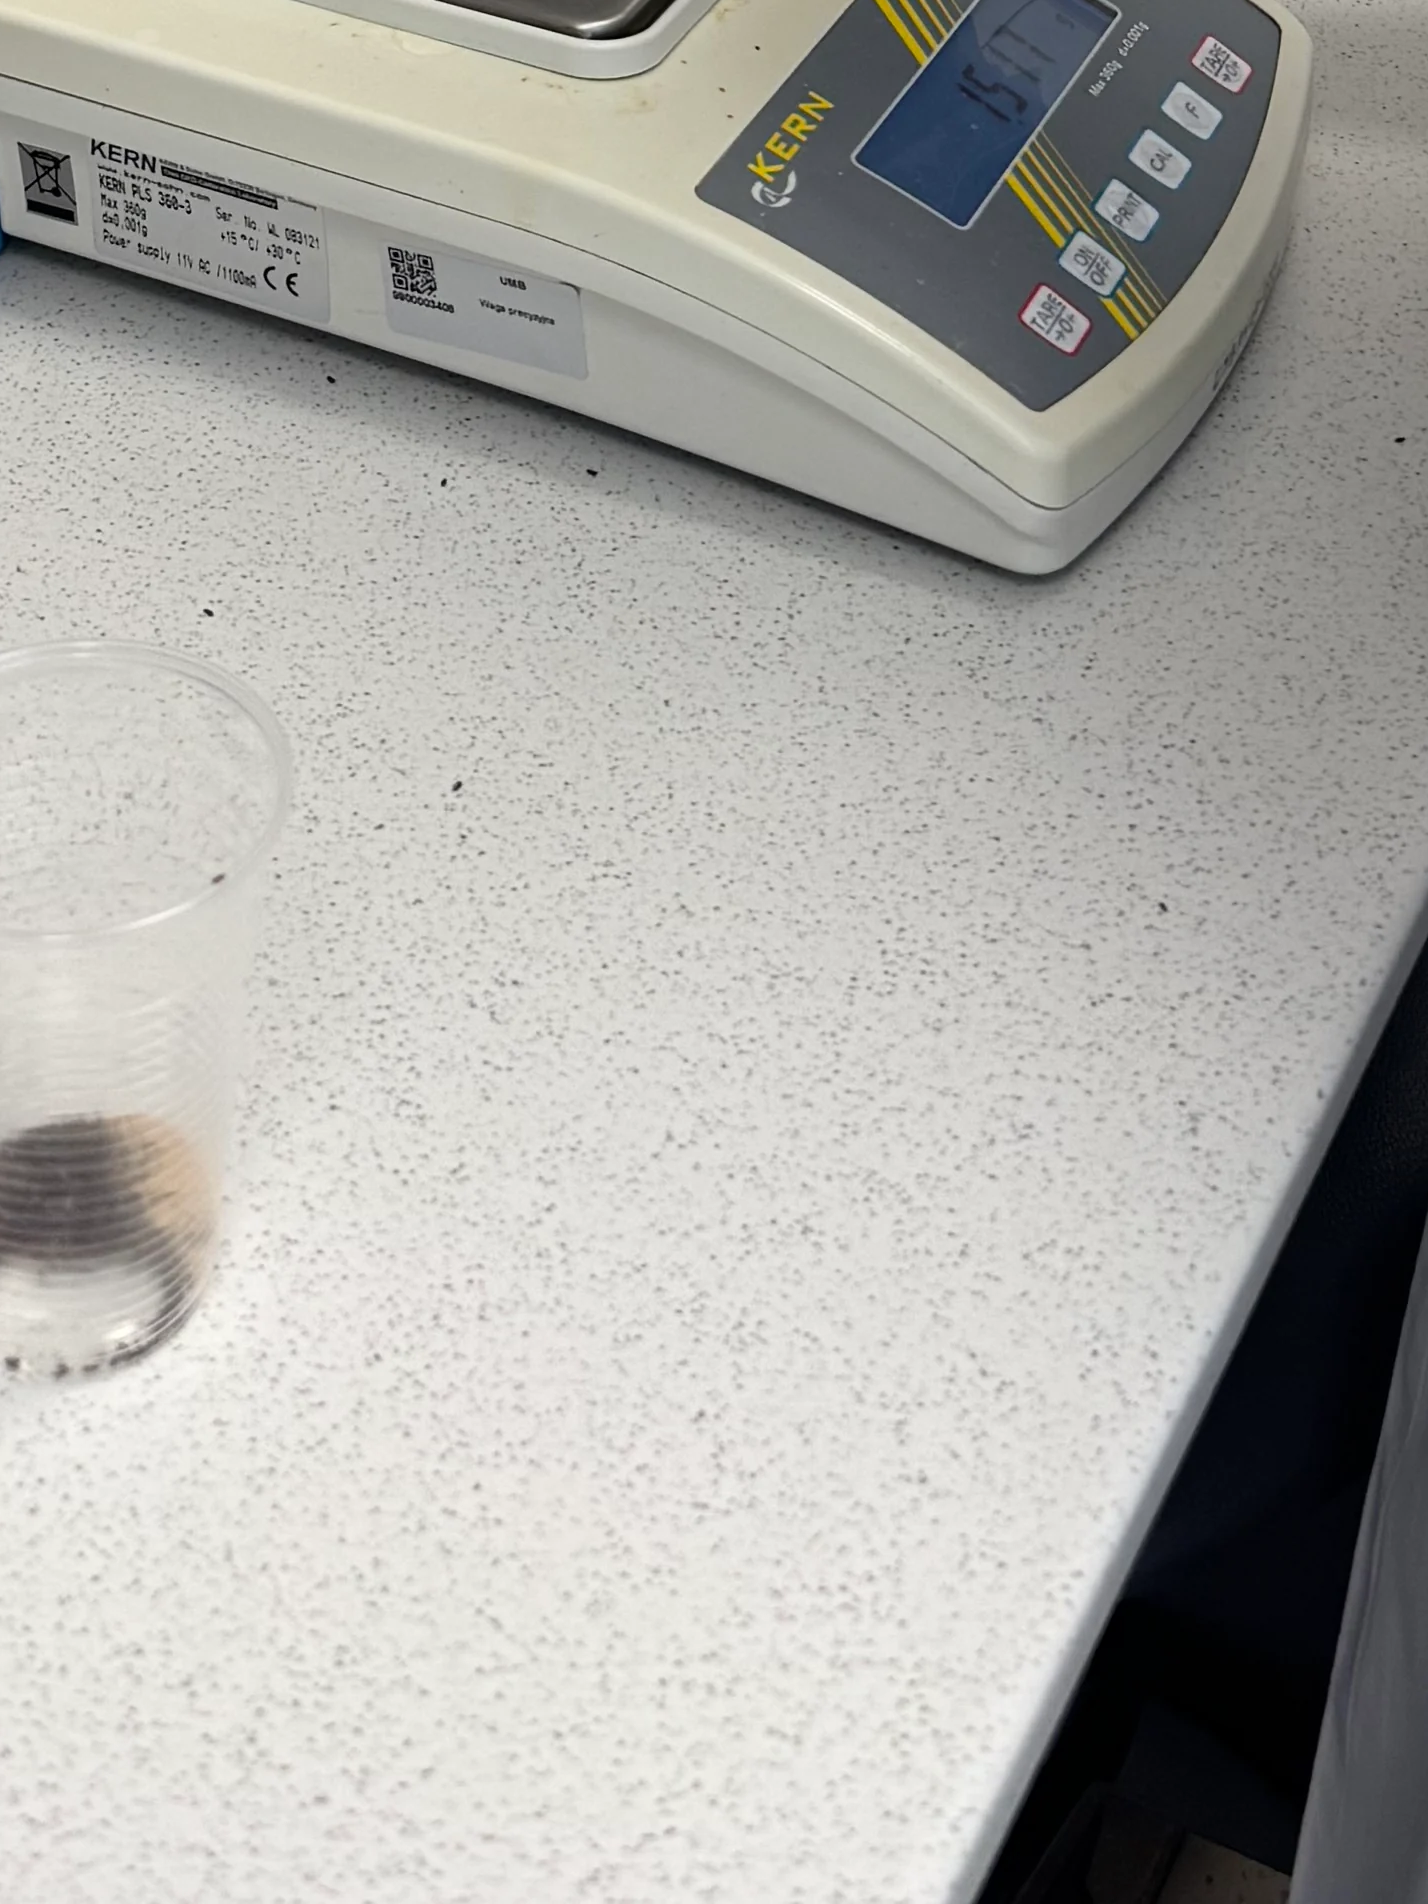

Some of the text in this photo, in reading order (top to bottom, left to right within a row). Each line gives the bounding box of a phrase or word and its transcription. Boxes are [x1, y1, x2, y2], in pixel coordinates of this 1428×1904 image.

[1184, 101, 1200, 120] F
[746, 90, 835, 184] KERN
[90, 138, 157, 174] KERN
[1149, 148, 1173, 173] CAL
[102, 228, 131, 250] Power
[136, 241, 172, 266] supply
[1089, 255, 1113, 287] OFF
[1029, 292, 1062, 331] TARE
